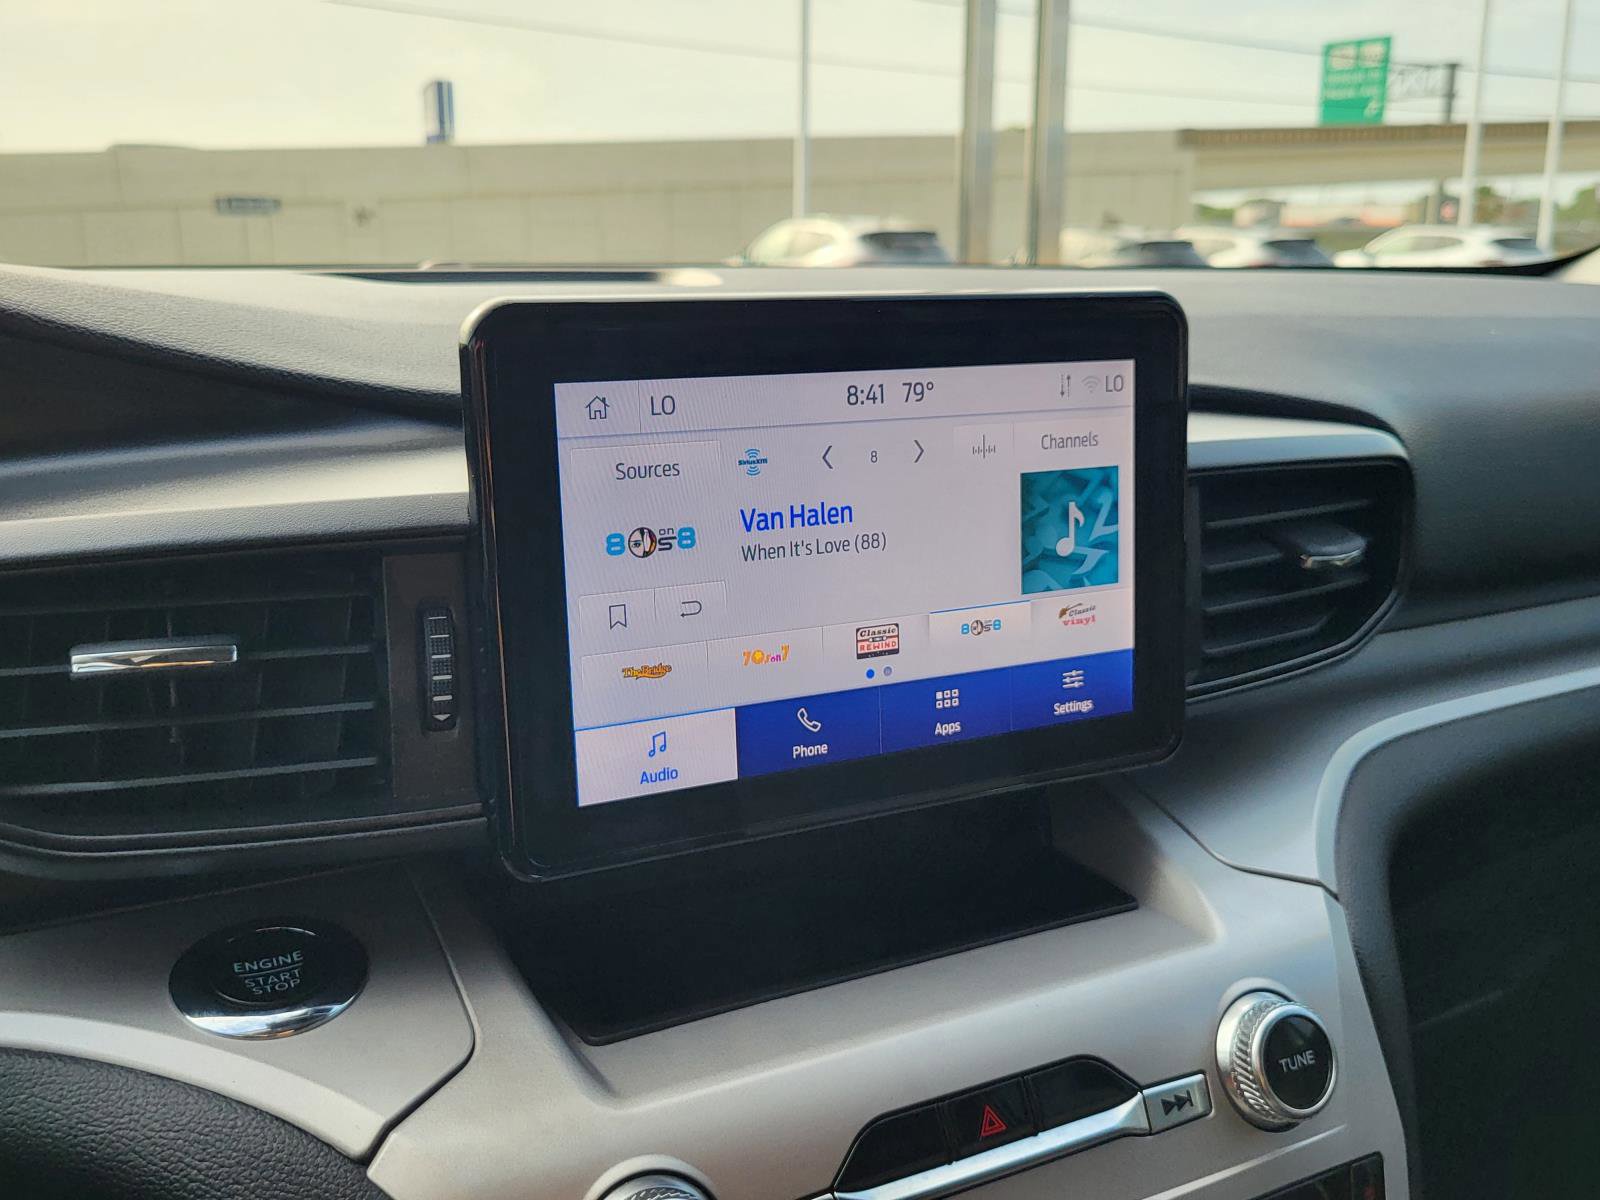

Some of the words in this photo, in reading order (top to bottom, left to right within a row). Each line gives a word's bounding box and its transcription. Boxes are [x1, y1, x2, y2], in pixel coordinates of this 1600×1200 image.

[1105, 374, 1124, 393] LO
[847, 384, 884, 406] 8:41
[902, 381, 934, 403] 79°
[650, 395, 676, 416] LO
[1041, 431, 1099, 450] Channels
[870, 450, 878, 463] 8
[615, 462, 680, 480] Sources
[740, 508, 784, 532] Van
[790, 501, 853, 528] Halen
[742, 544, 785, 562] When
[790, 540, 812, 557] It's
[816, 538, 850, 554] Love
[855, 532, 887, 553] (88)
[860, 627, 896, 637] Classic
[860, 641, 896, 651] REWIND
[1053, 699, 1093, 715] Settings
[935, 720, 961, 736] Apps
[792, 743, 828, 759] Phone
[639, 767, 678, 785] Audio
[233, 950, 304, 973] ENGINE
[245, 969, 301, 988] START
[253, 979, 301, 995] STOP
[1279, 1050, 1316, 1072] TUNE
